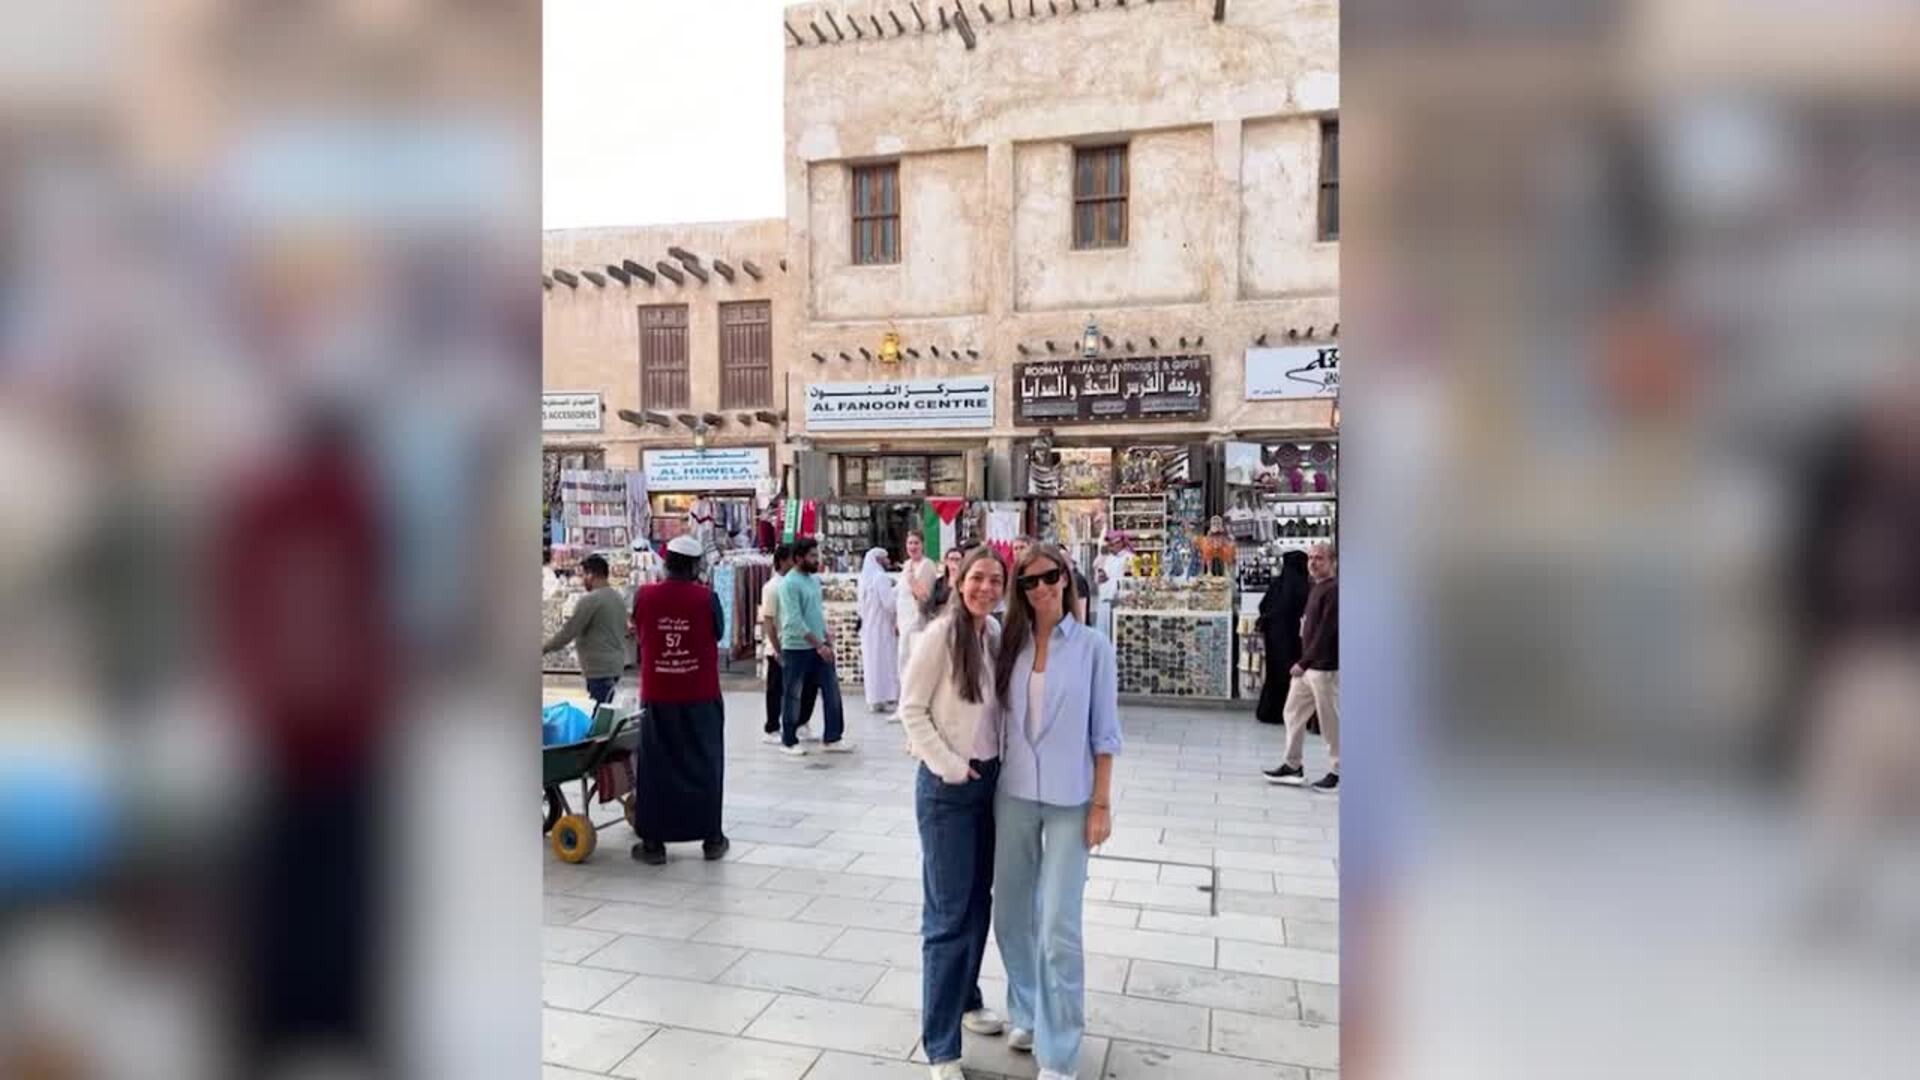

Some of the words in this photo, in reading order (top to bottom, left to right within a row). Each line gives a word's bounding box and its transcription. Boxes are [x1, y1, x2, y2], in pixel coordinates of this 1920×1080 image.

[812, 402, 834, 412] AL
[837, 400, 910, 411] FANOON
[913, 398, 988, 410] CENTRE
[549, 410, 597, 419] ACCESSORIES
[683, 466, 750, 475] HUWELA
[665, 633, 682, 647] 57
